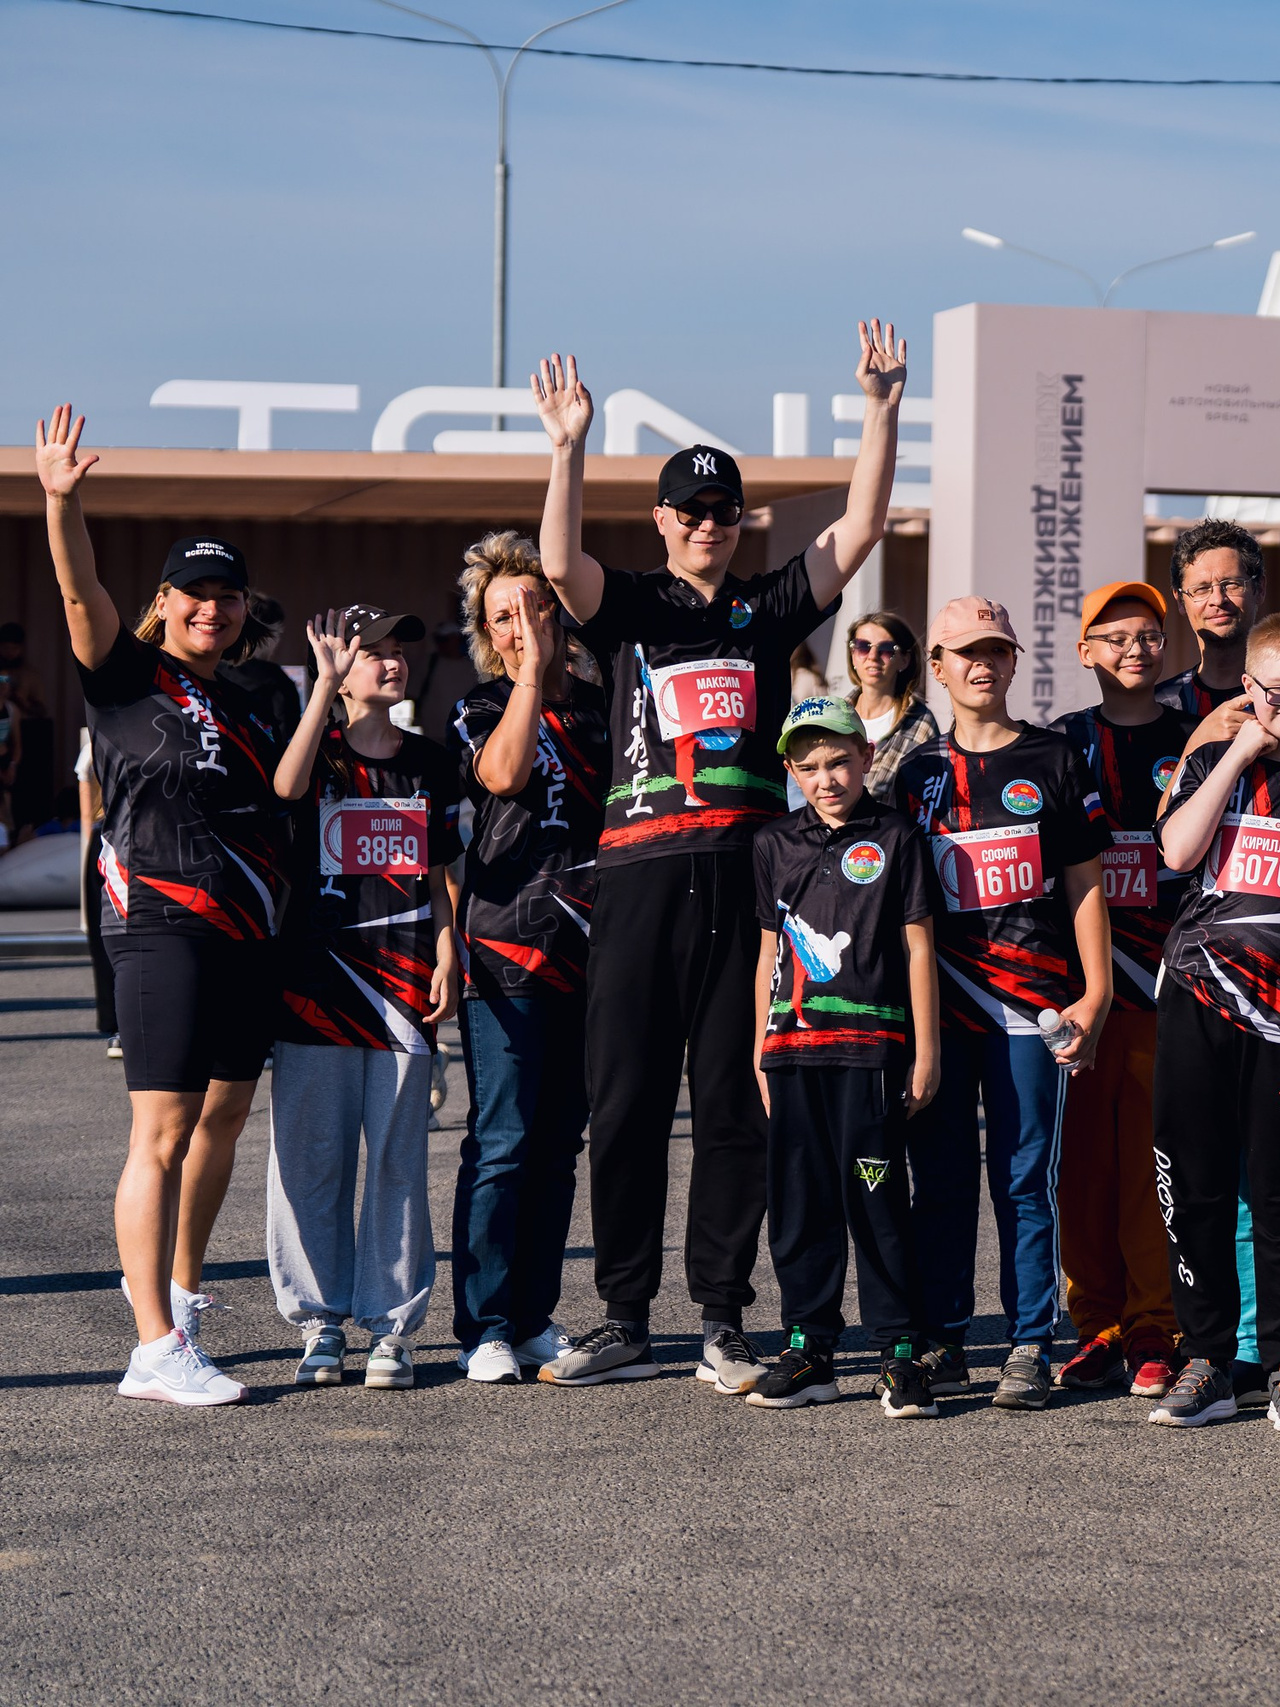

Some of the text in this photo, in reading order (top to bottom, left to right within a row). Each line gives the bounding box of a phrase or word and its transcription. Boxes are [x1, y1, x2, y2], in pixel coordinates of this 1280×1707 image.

[692, 453, 717, 475] NY
[1058, 374, 1084, 618] ДВИЖЕНИЕМ
[185, 548, 234, 561] ВСЕГДА ПРАВ
[195, 542, 224, 551] ТРЕНЕР
[1031, 484, 1057, 728] ДВИЖЕНИЕМ
[695, 676, 741, 690] МАКСИМ
[698, 691, 746, 721] 236
[370, 818, 402, 832] ЮЛИЯ
[356, 835, 419, 866] 3859
[981, 846, 1018, 863] СОФИЯ
[974, 861, 1034, 898] 1610
[853, 1164, 891, 1180] BLACK
